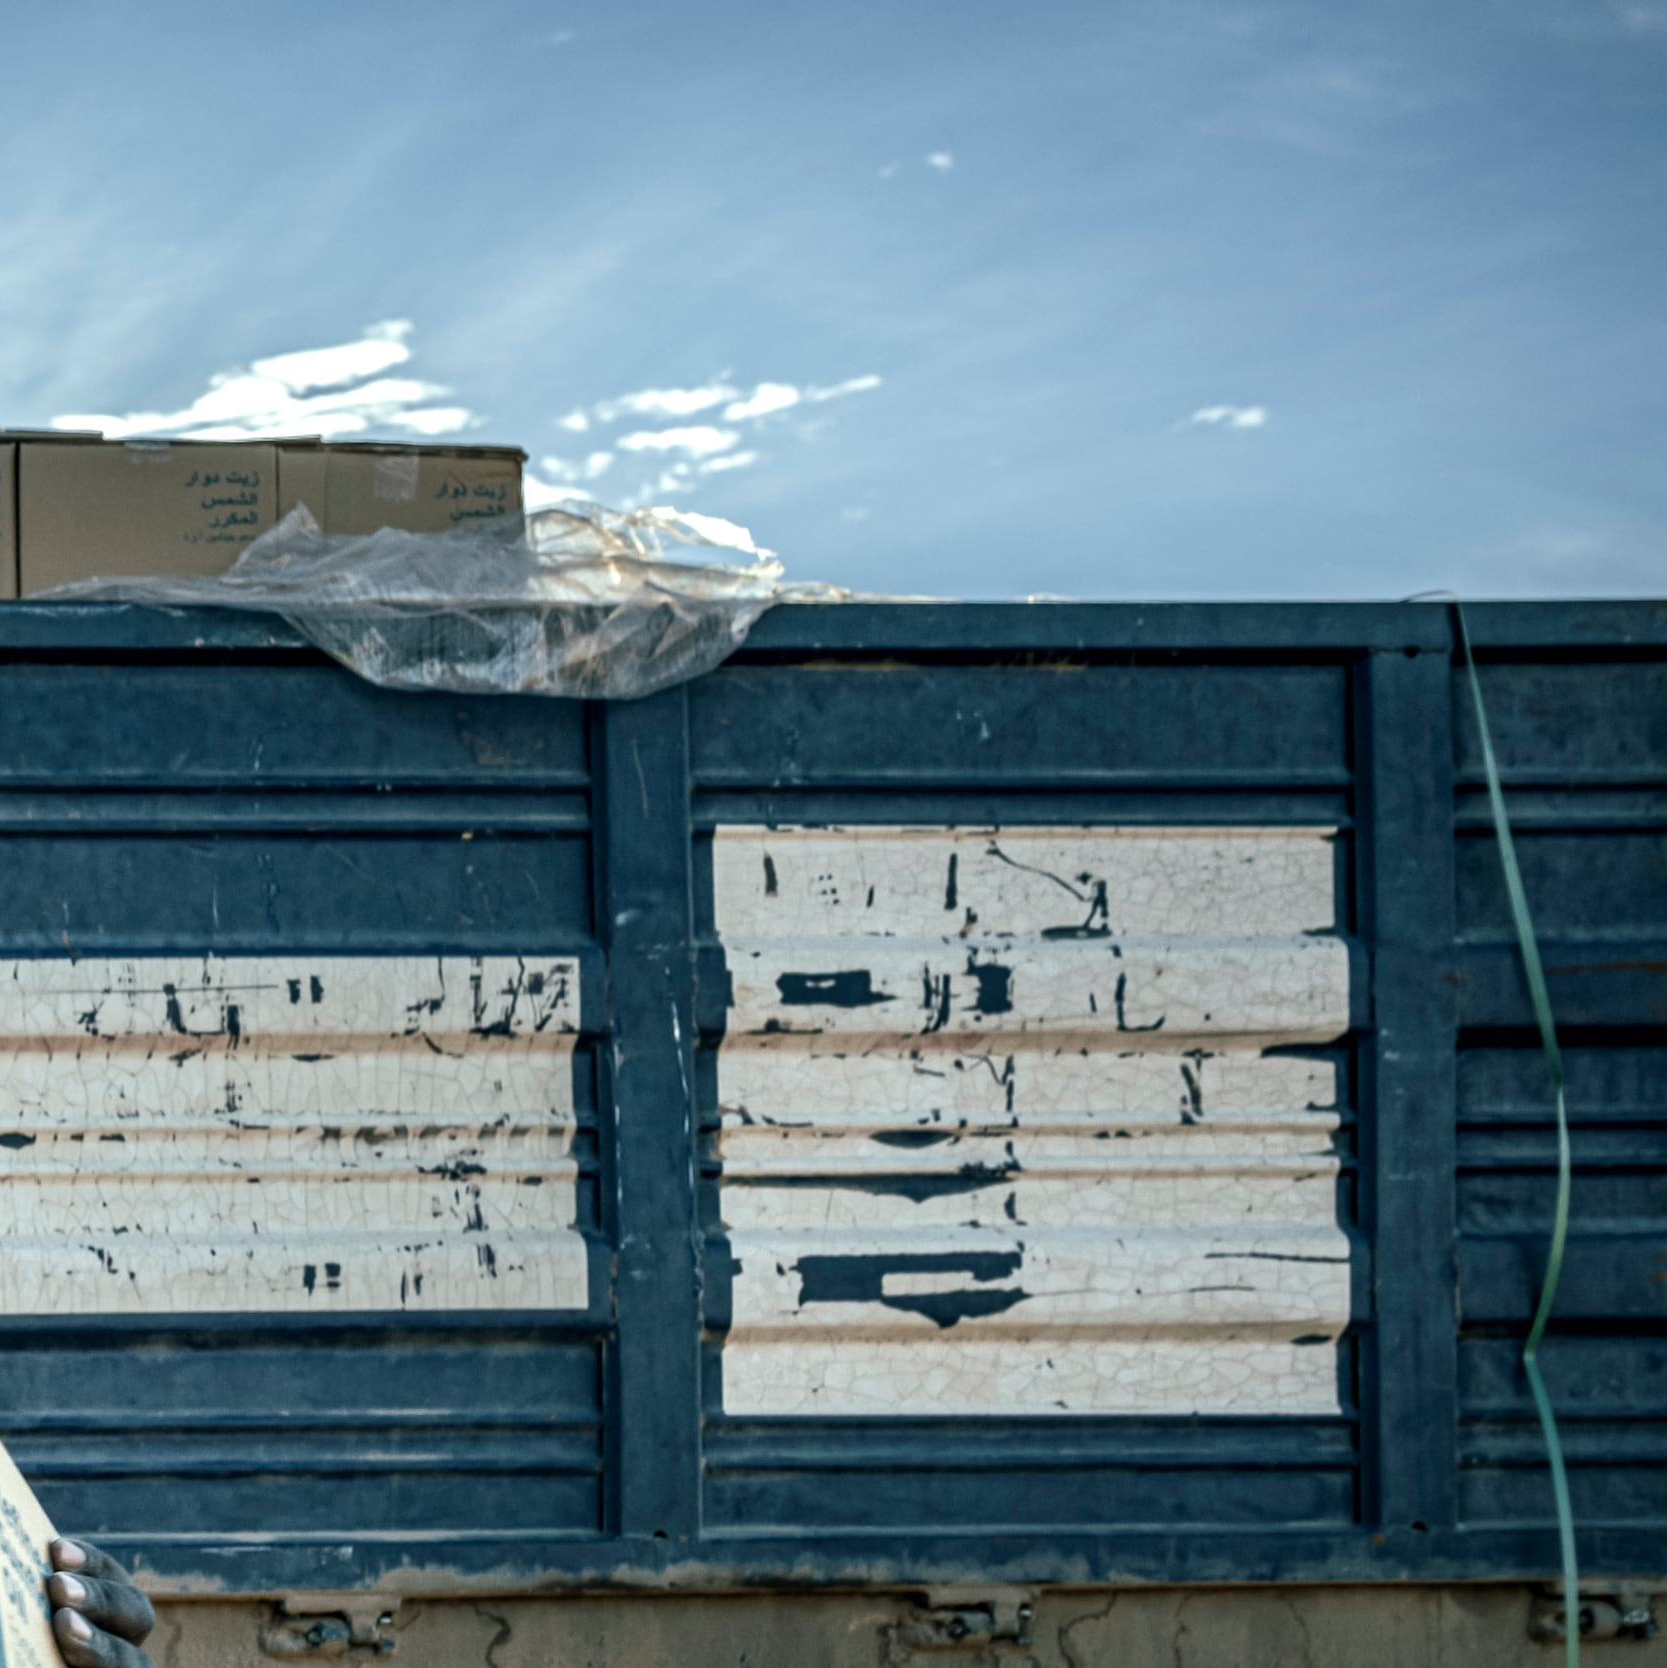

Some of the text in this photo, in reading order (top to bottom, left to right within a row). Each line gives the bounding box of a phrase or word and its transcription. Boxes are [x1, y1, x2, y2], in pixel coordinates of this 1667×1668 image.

[185, 470, 260, 488] زيت دوار
[473, 483, 506, 500] زيت
[200, 492, 259, 510] الشمس
